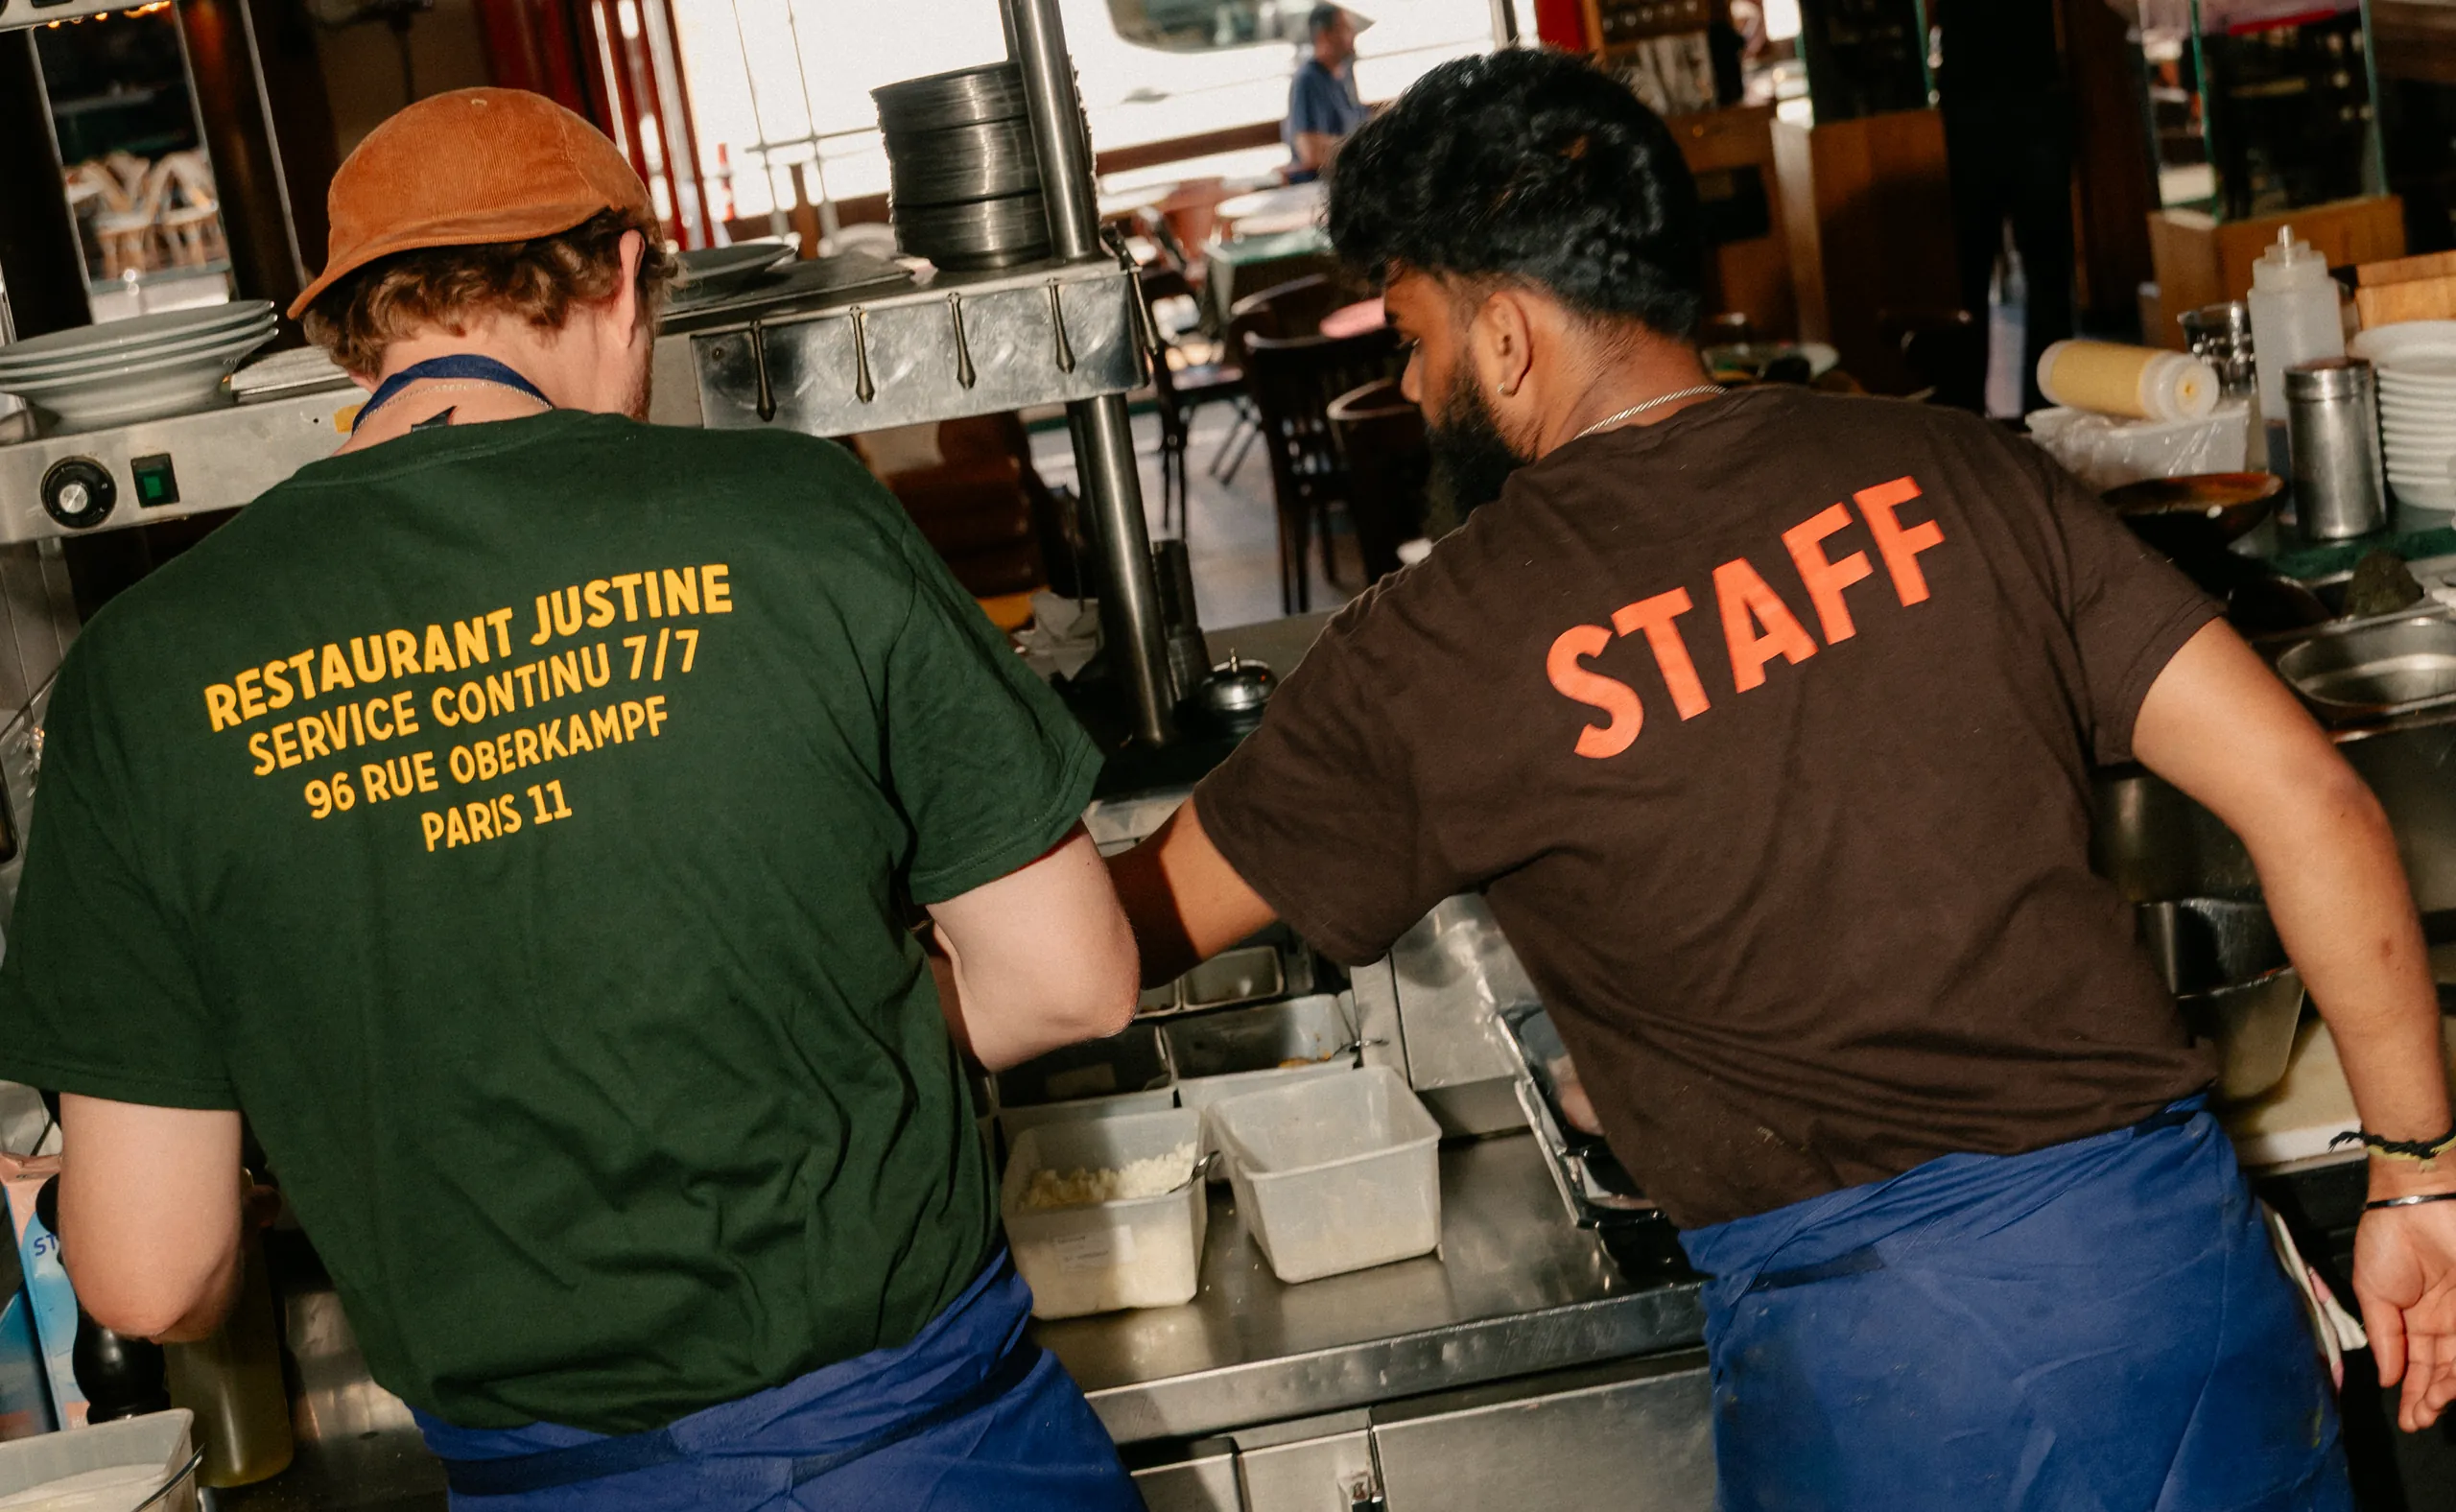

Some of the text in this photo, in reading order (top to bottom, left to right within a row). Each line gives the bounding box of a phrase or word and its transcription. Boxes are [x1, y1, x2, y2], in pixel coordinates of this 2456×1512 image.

[203, 563, 734, 733] RESTAURANT JUSTINE
[1547, 476, 1946, 759] STAFF
[248, 626, 700, 777] SERVICE CONTINU 7/7
[303, 694, 669, 819] 96 RUE OBERKAMPF
[420, 779, 574, 853] PARIS 11
